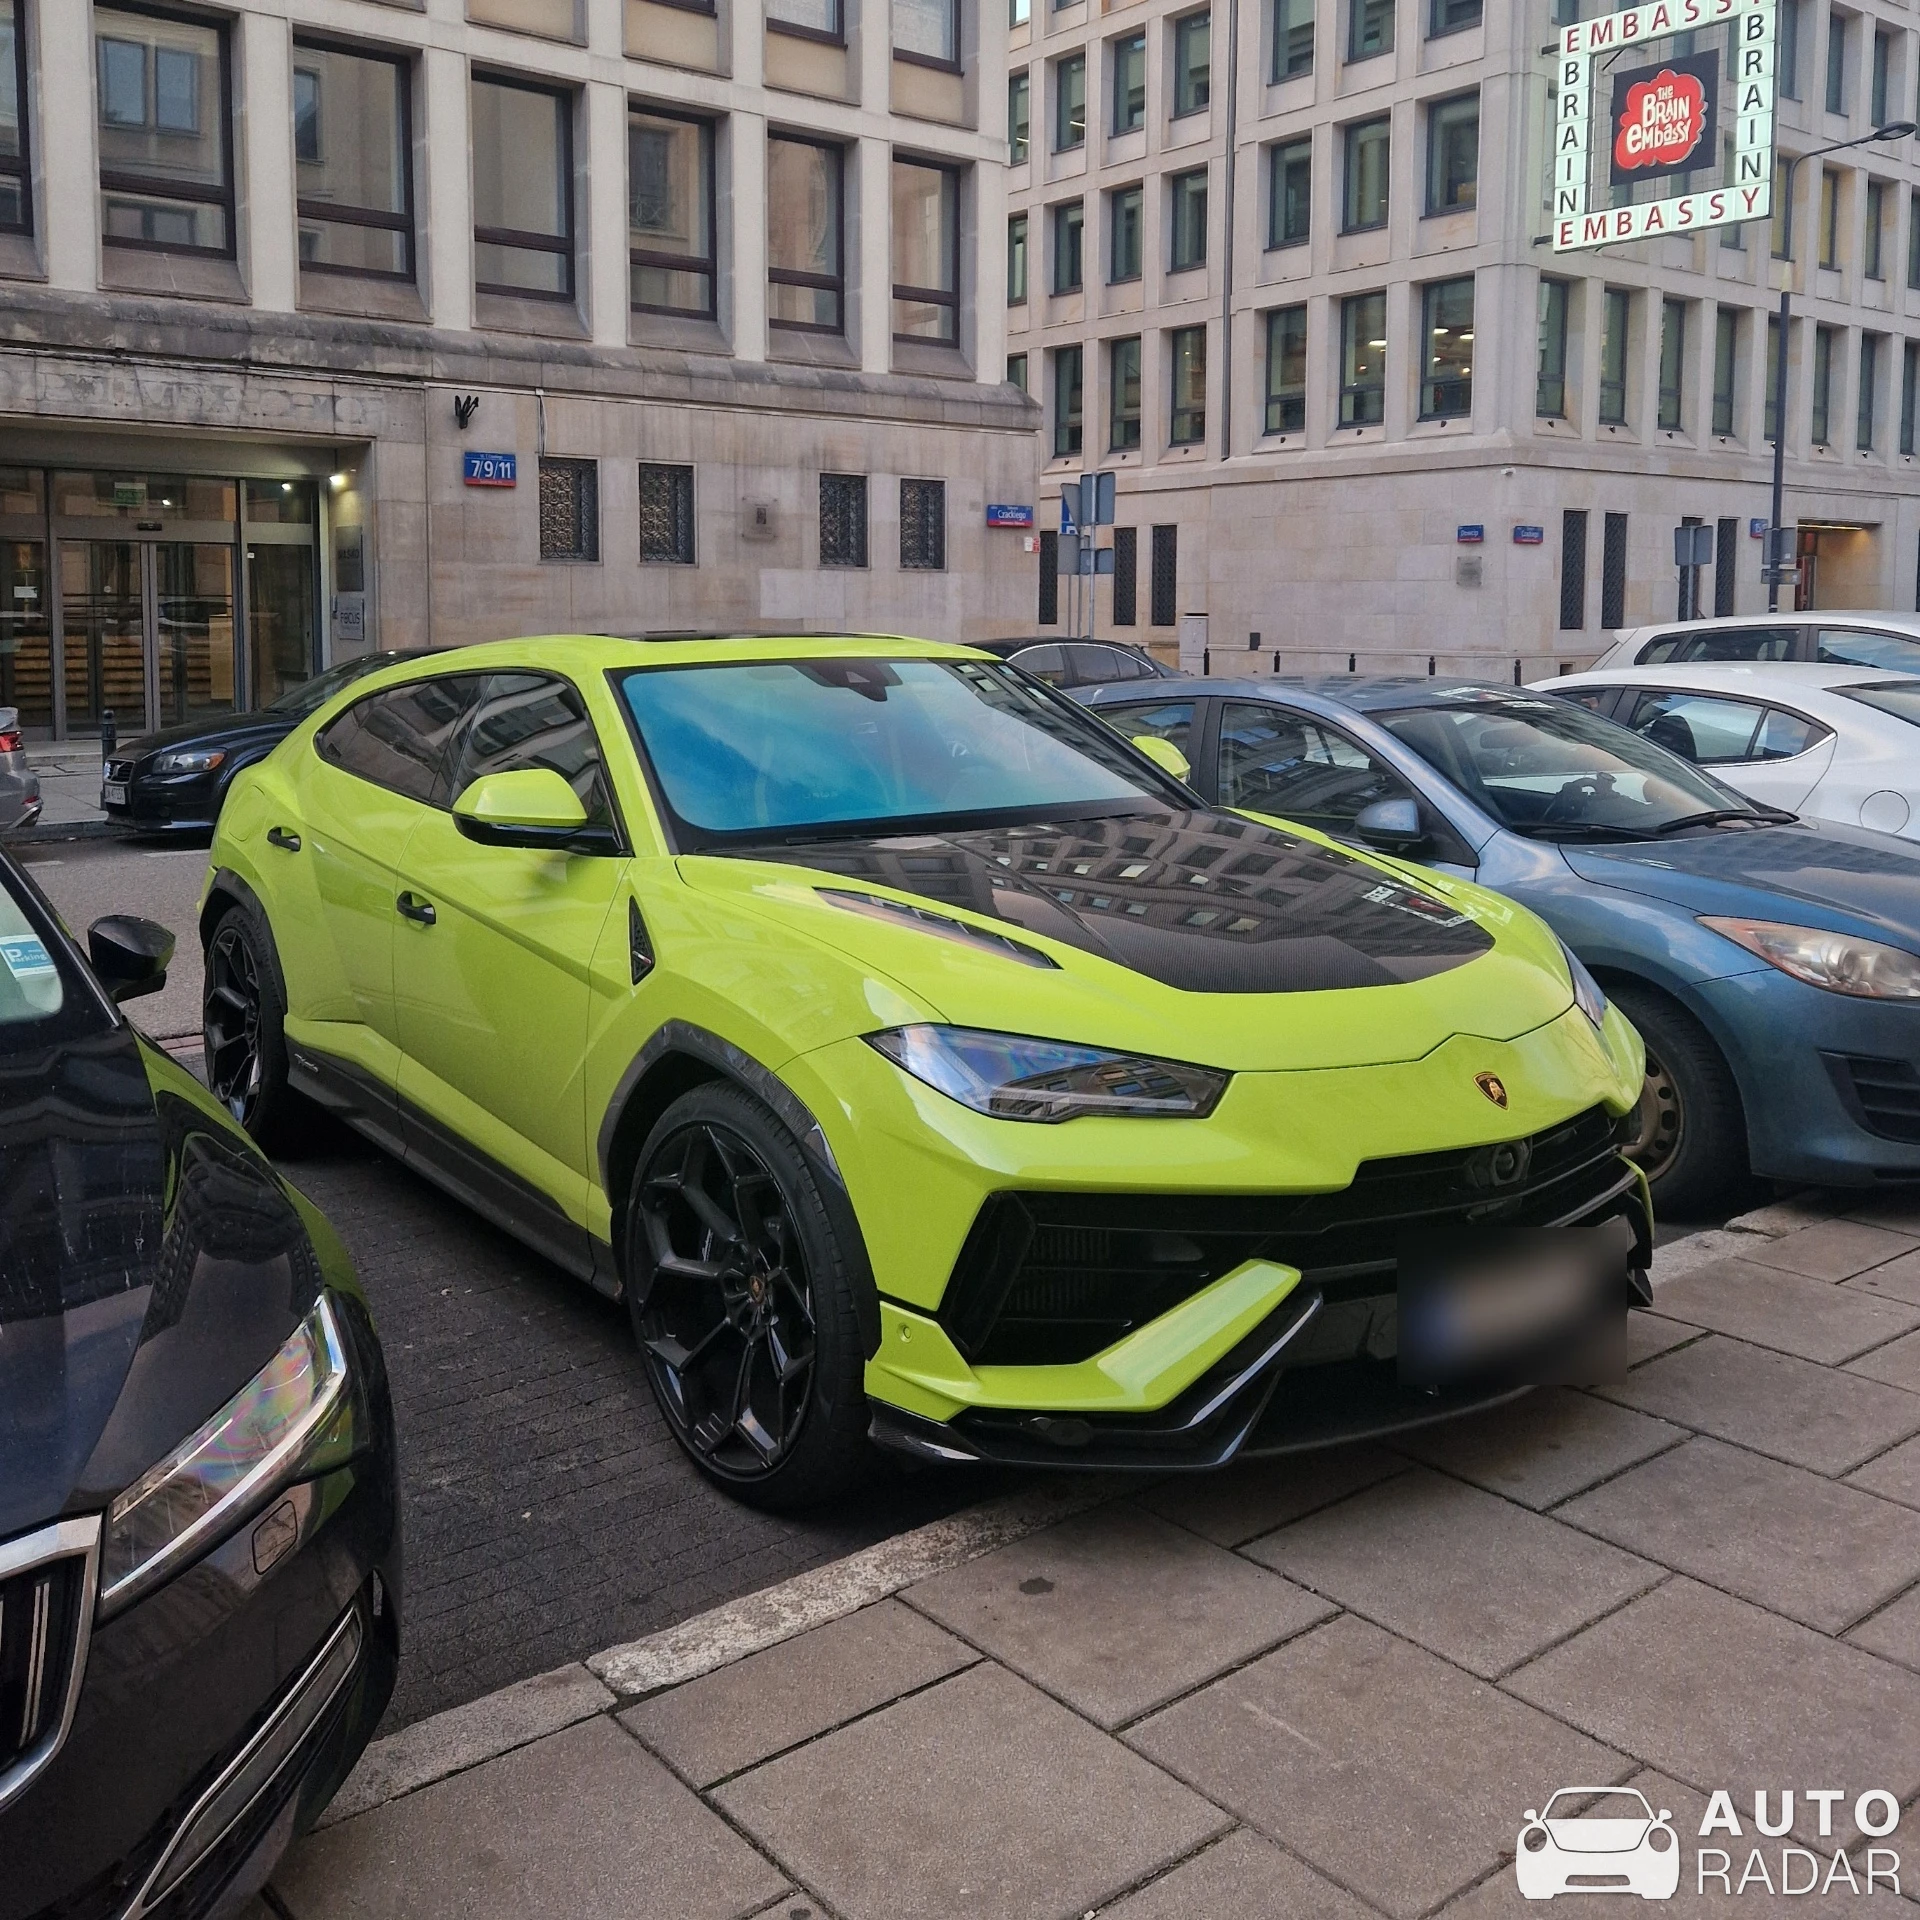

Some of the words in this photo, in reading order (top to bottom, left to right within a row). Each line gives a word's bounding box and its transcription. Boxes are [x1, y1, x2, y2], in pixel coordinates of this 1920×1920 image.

[1566, 0, 1760, 53] EMBASS
[1642, 94, 1690, 128] BRAIN
[1741, 13, 1765, 179] BRAIN
[1560, 61, 1581, 214] BRAIN
[1560, 186, 1760, 246] EMBASSY
[471, 460, 511, 479] 7/9/11
